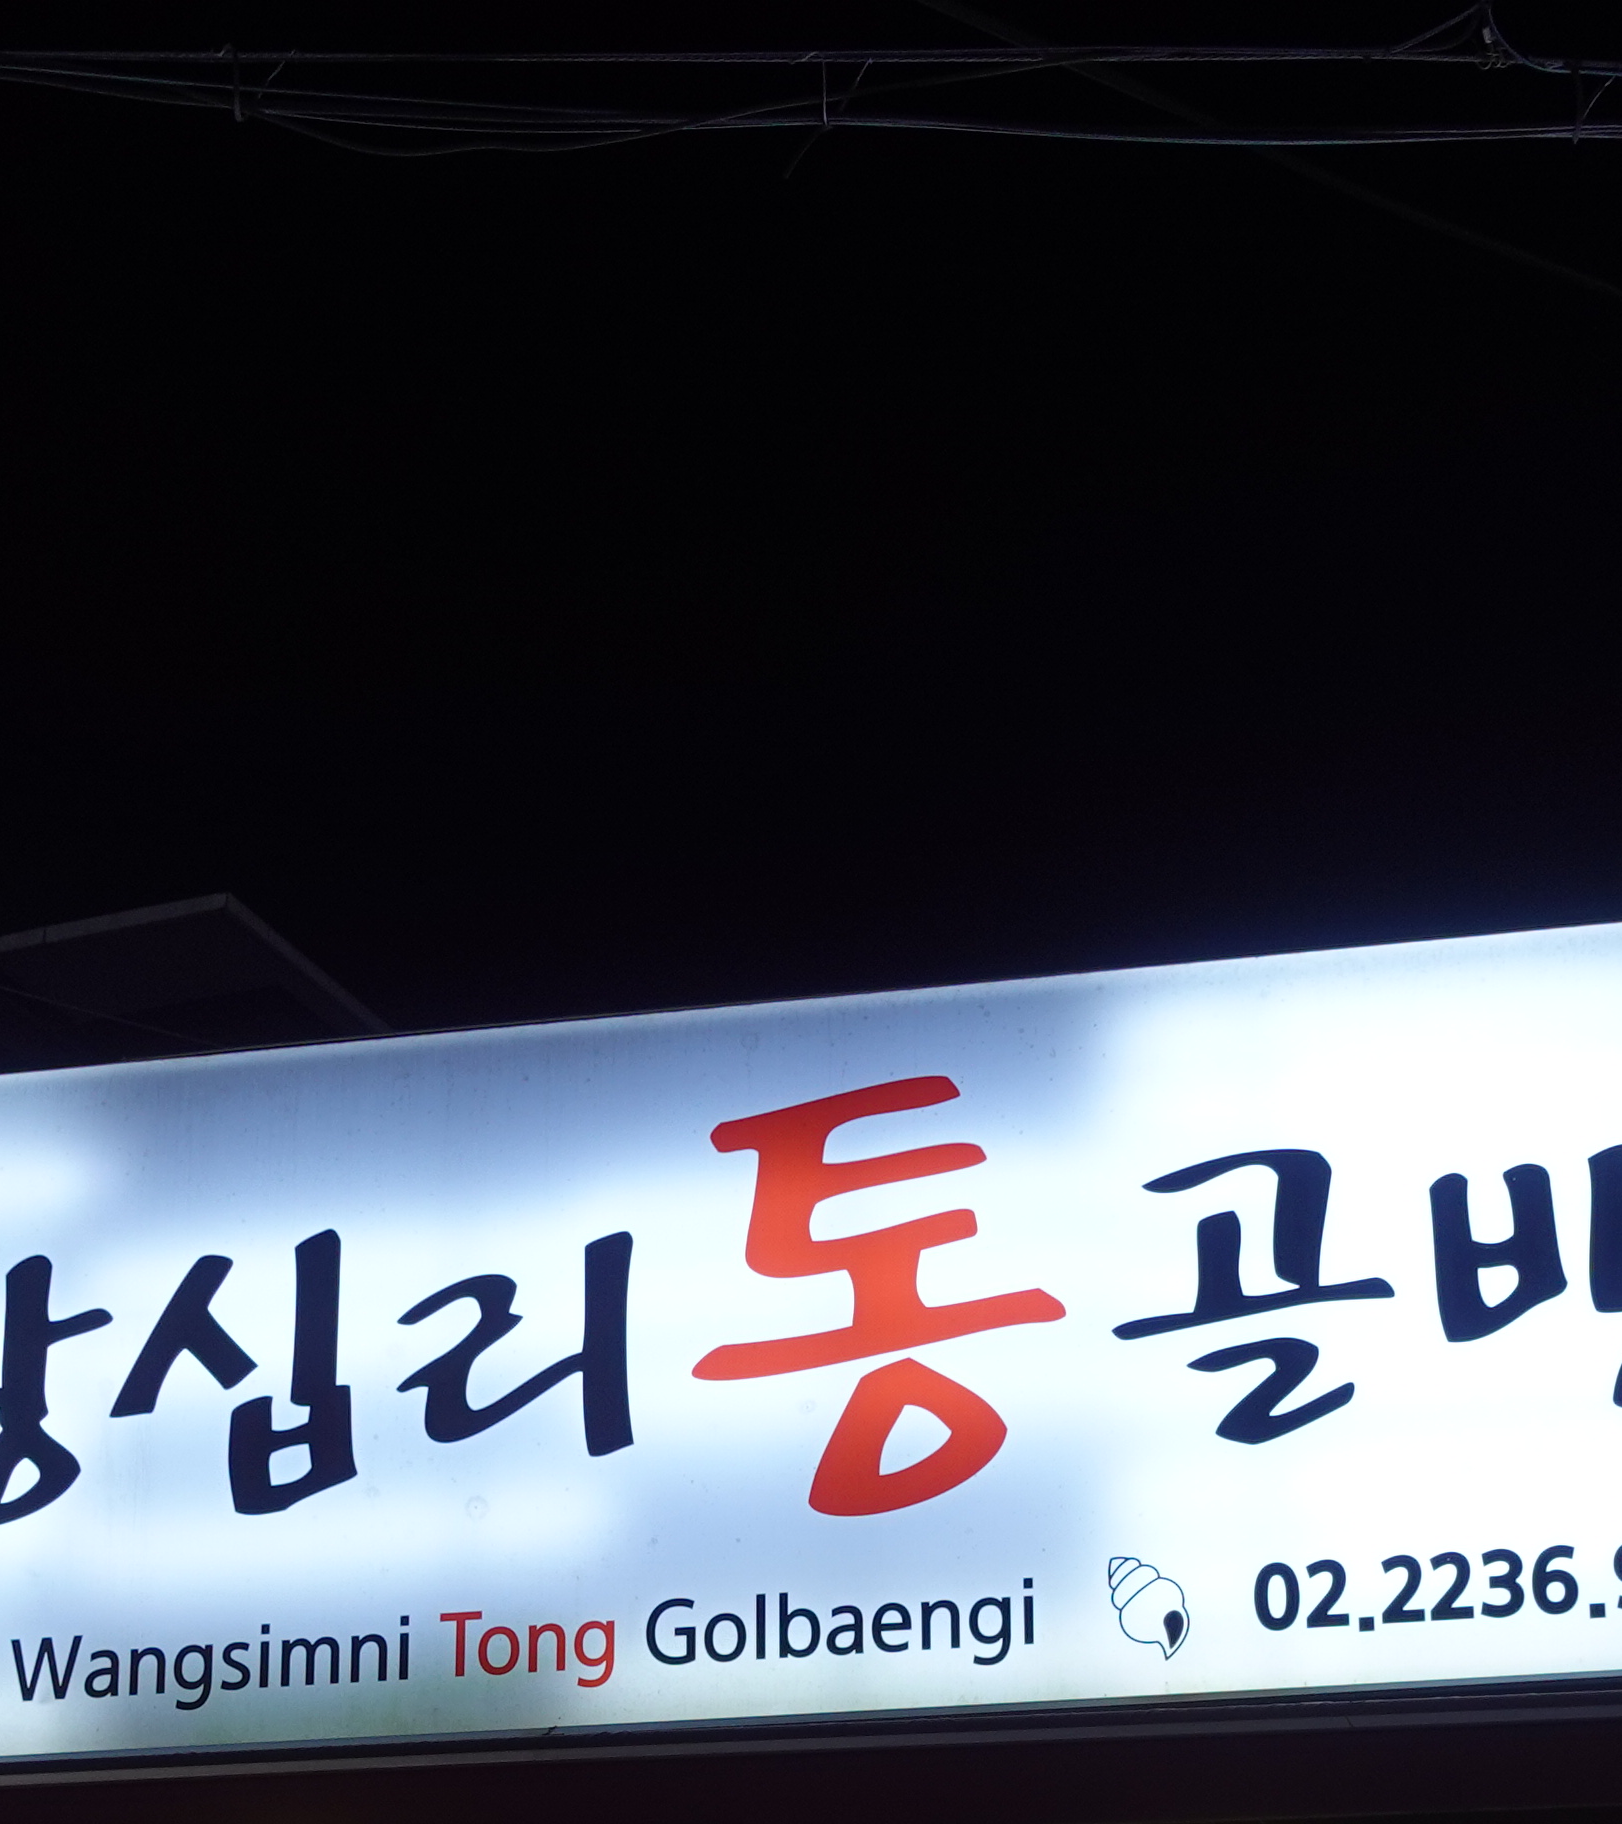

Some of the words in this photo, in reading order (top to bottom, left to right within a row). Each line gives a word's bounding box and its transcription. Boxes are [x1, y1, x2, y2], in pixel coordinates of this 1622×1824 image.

[11, 1614, 413, 1711] Wangsimni
[439, 1610, 617, 1689] Tong
[645, 1576, 1037, 1667] Golbaengi
